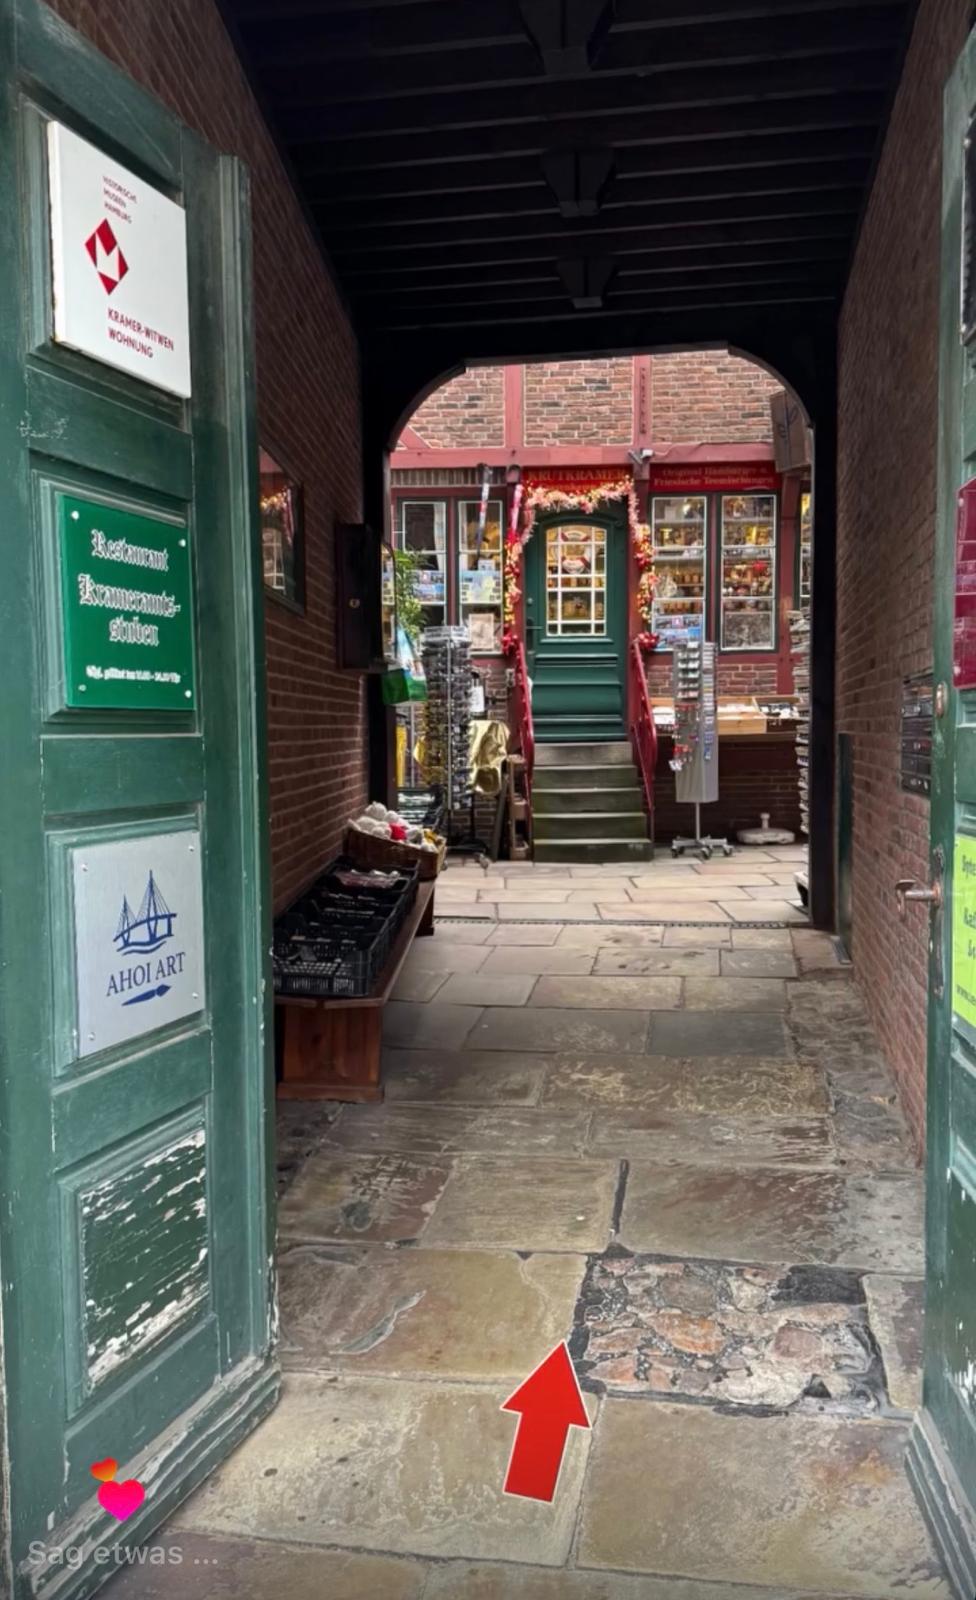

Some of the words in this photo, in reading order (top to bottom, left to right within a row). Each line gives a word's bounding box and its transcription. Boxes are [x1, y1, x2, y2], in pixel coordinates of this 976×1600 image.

[104, 201, 133, 224] HAMBURG
[107, 307, 175, 351] KRAMER-WITWEN
[107, 326, 154, 359] WOHNUNG
[91, 529, 169, 572] Restaurant
[106, 962, 151, 997] AHOI
[155, 951, 186, 980] ART
